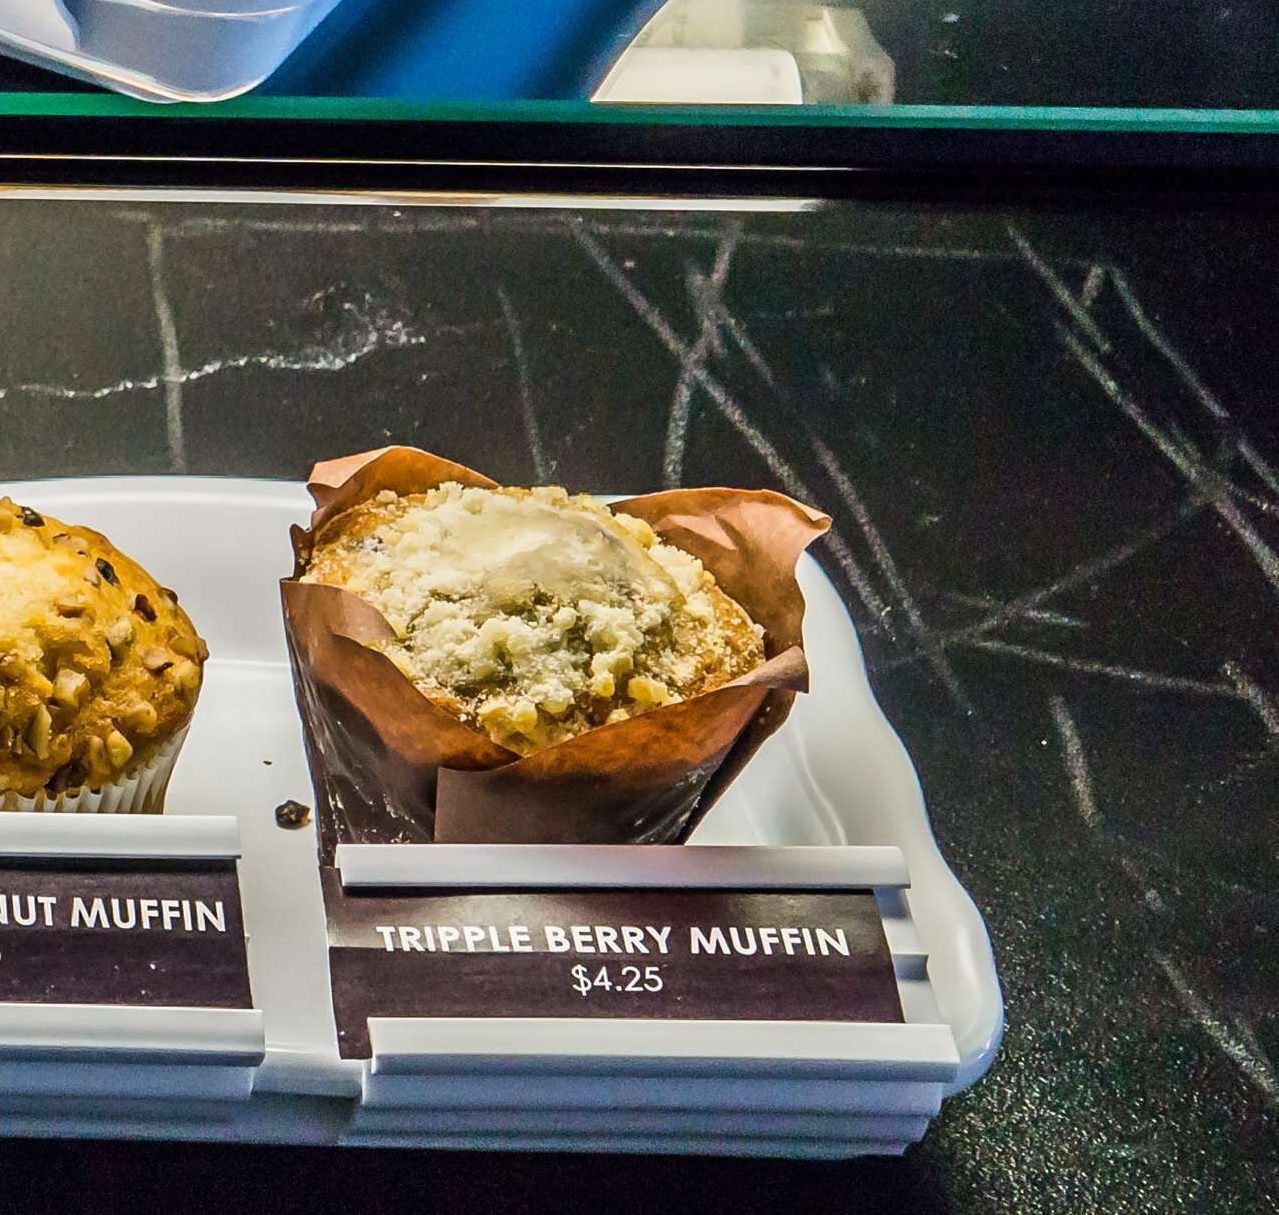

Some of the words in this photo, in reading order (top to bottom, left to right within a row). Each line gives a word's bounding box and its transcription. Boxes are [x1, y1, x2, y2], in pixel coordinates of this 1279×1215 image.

[69, 896, 227, 933] MUFFIN
[374, 924, 534, 954] TRIPPLE
[543, 925, 673, 955] BERRY
[689, 925, 851, 957] MUFFIN
[570, 963, 664, 997] $4.25
